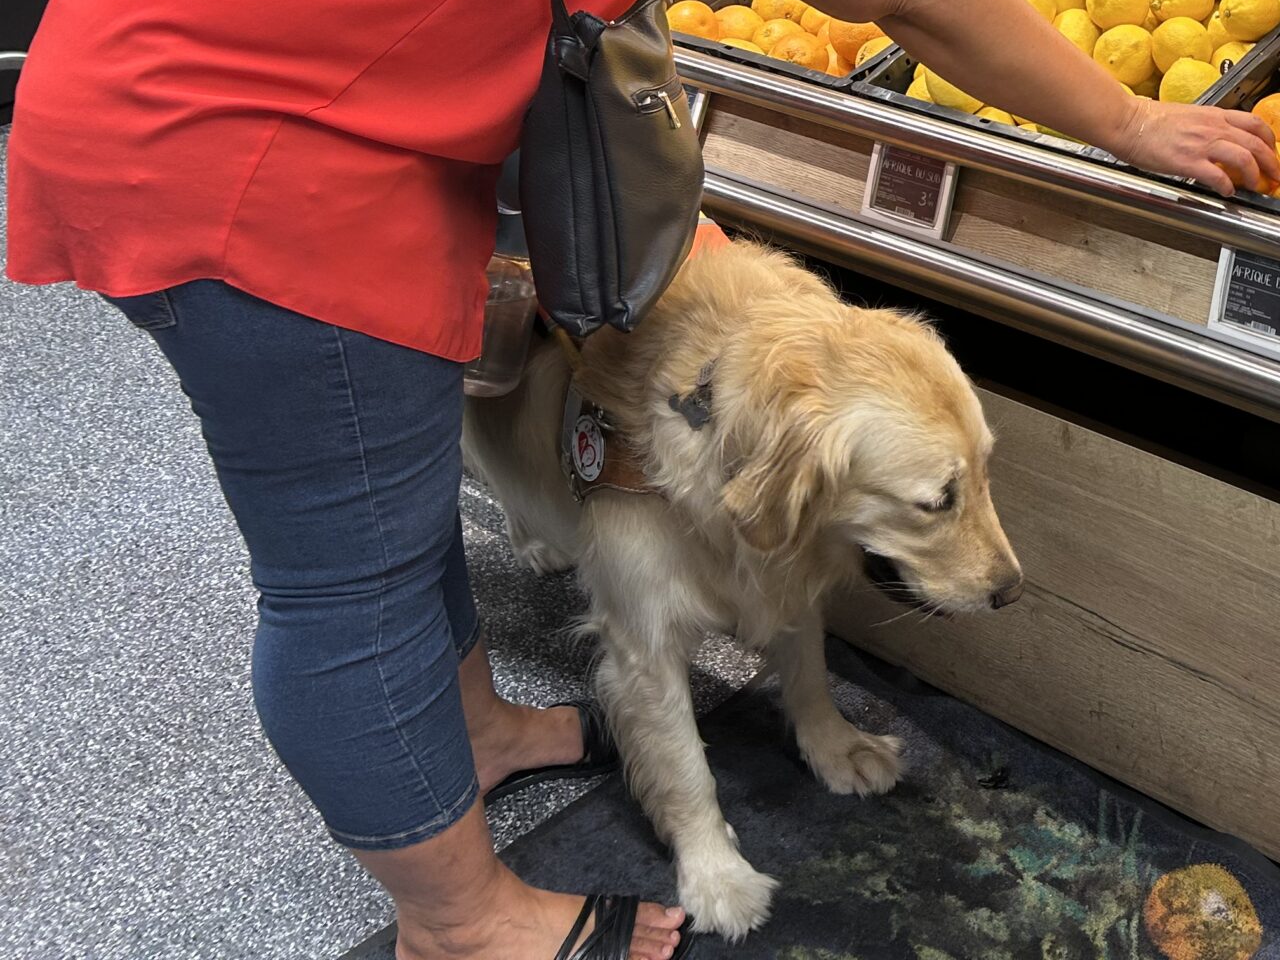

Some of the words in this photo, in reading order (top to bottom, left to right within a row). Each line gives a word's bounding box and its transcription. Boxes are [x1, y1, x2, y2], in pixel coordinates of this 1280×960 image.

[883, 160, 913, 177] AFRIQUE
[915, 169, 925, 179] DU
[925, 172, 941, 183] SUD
[918, 192, 927, 206] 3
[1232, 265, 1273, 286] AFRIQUE
